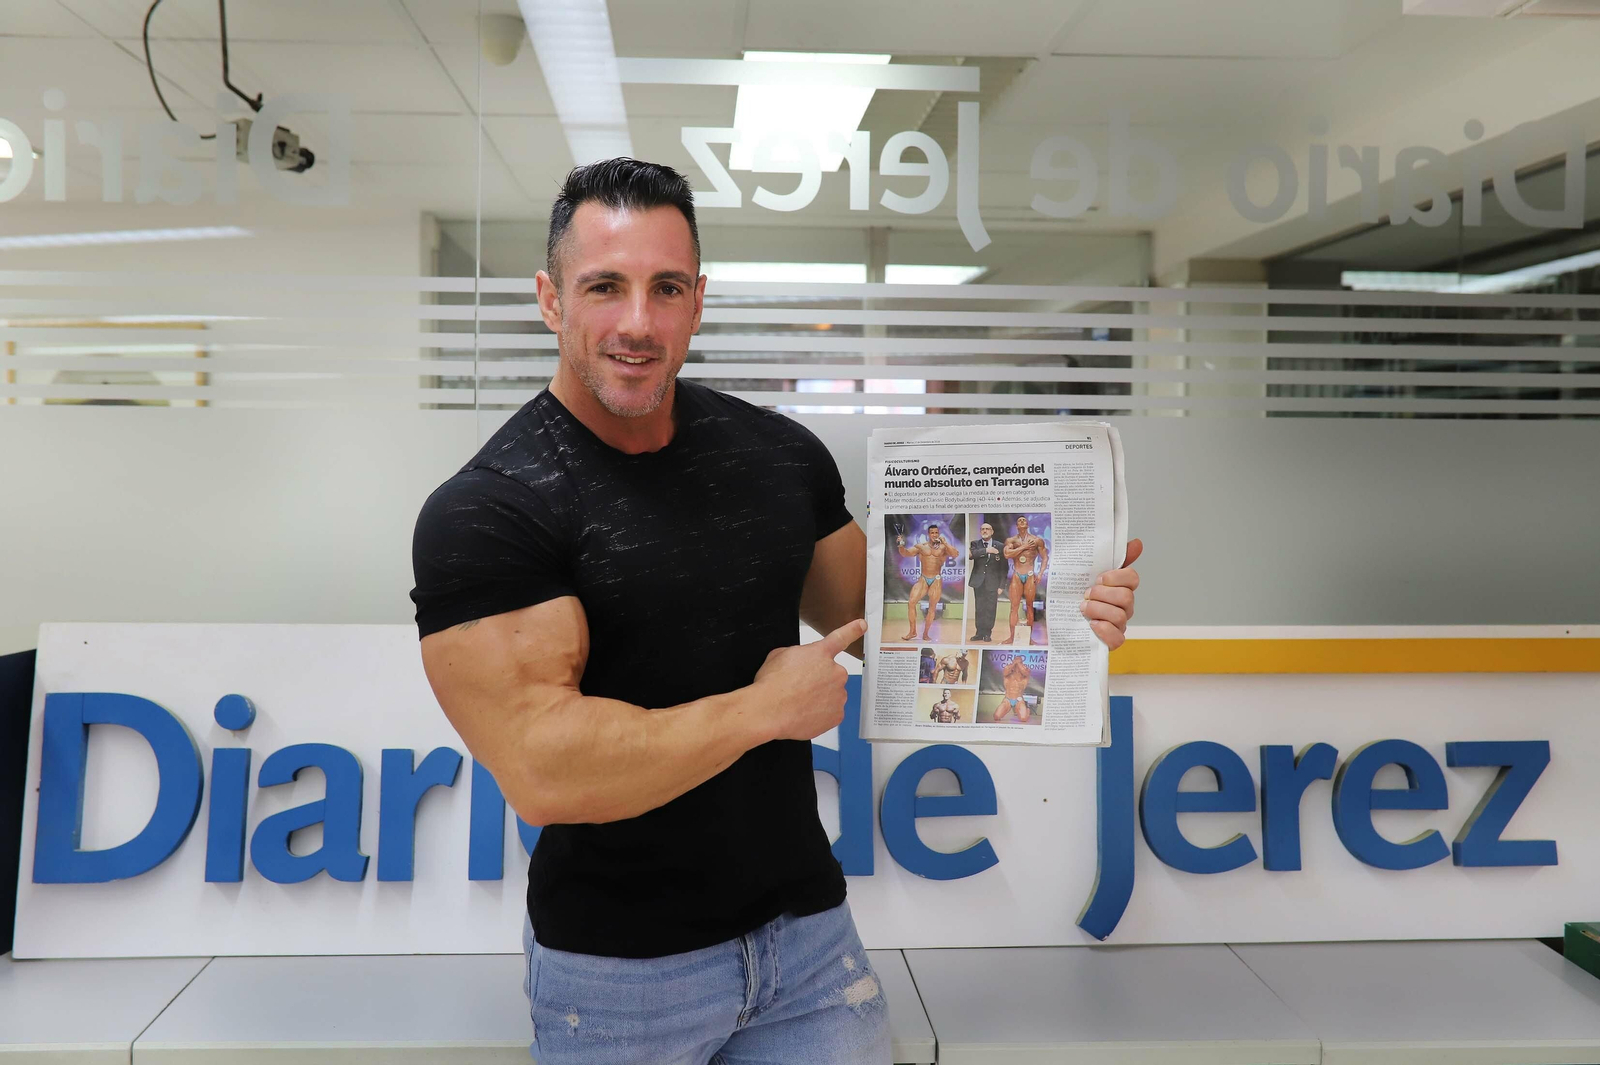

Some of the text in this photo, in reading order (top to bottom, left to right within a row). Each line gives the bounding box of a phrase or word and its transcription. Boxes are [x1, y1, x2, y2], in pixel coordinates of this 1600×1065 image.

[884, 463, 1045, 476] Álvaro Ordóñez, campeón del
[884, 477, 1049, 488] mundo absoluto en Tarragona
[991, 653, 1027, 662] WORD
[32, 692, 545, 884] Diari
[1075, 695, 1558, 941] Jerez
